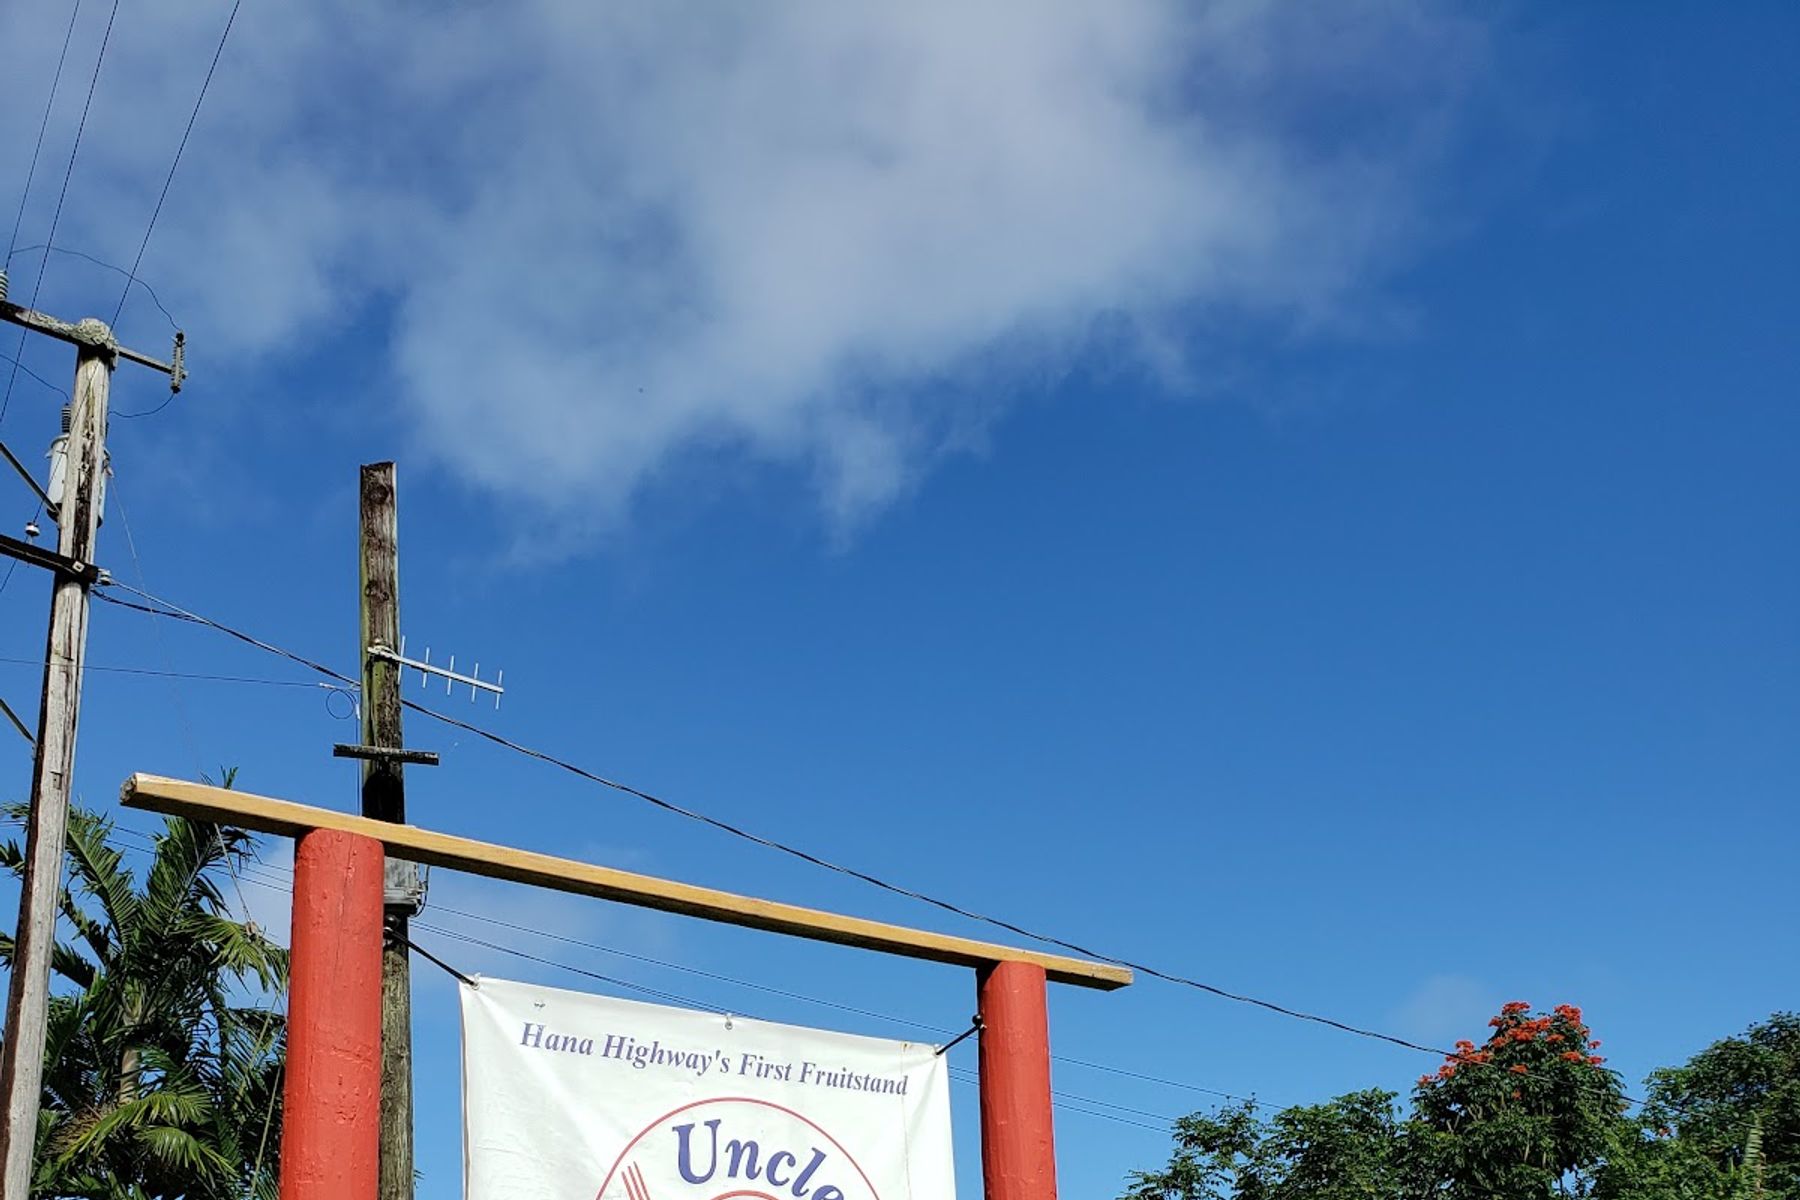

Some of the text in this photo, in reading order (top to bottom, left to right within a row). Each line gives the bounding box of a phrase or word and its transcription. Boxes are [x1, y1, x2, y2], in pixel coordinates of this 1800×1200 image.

[520, 1021, 909, 1096] Hana Highway's First Fruitstand
